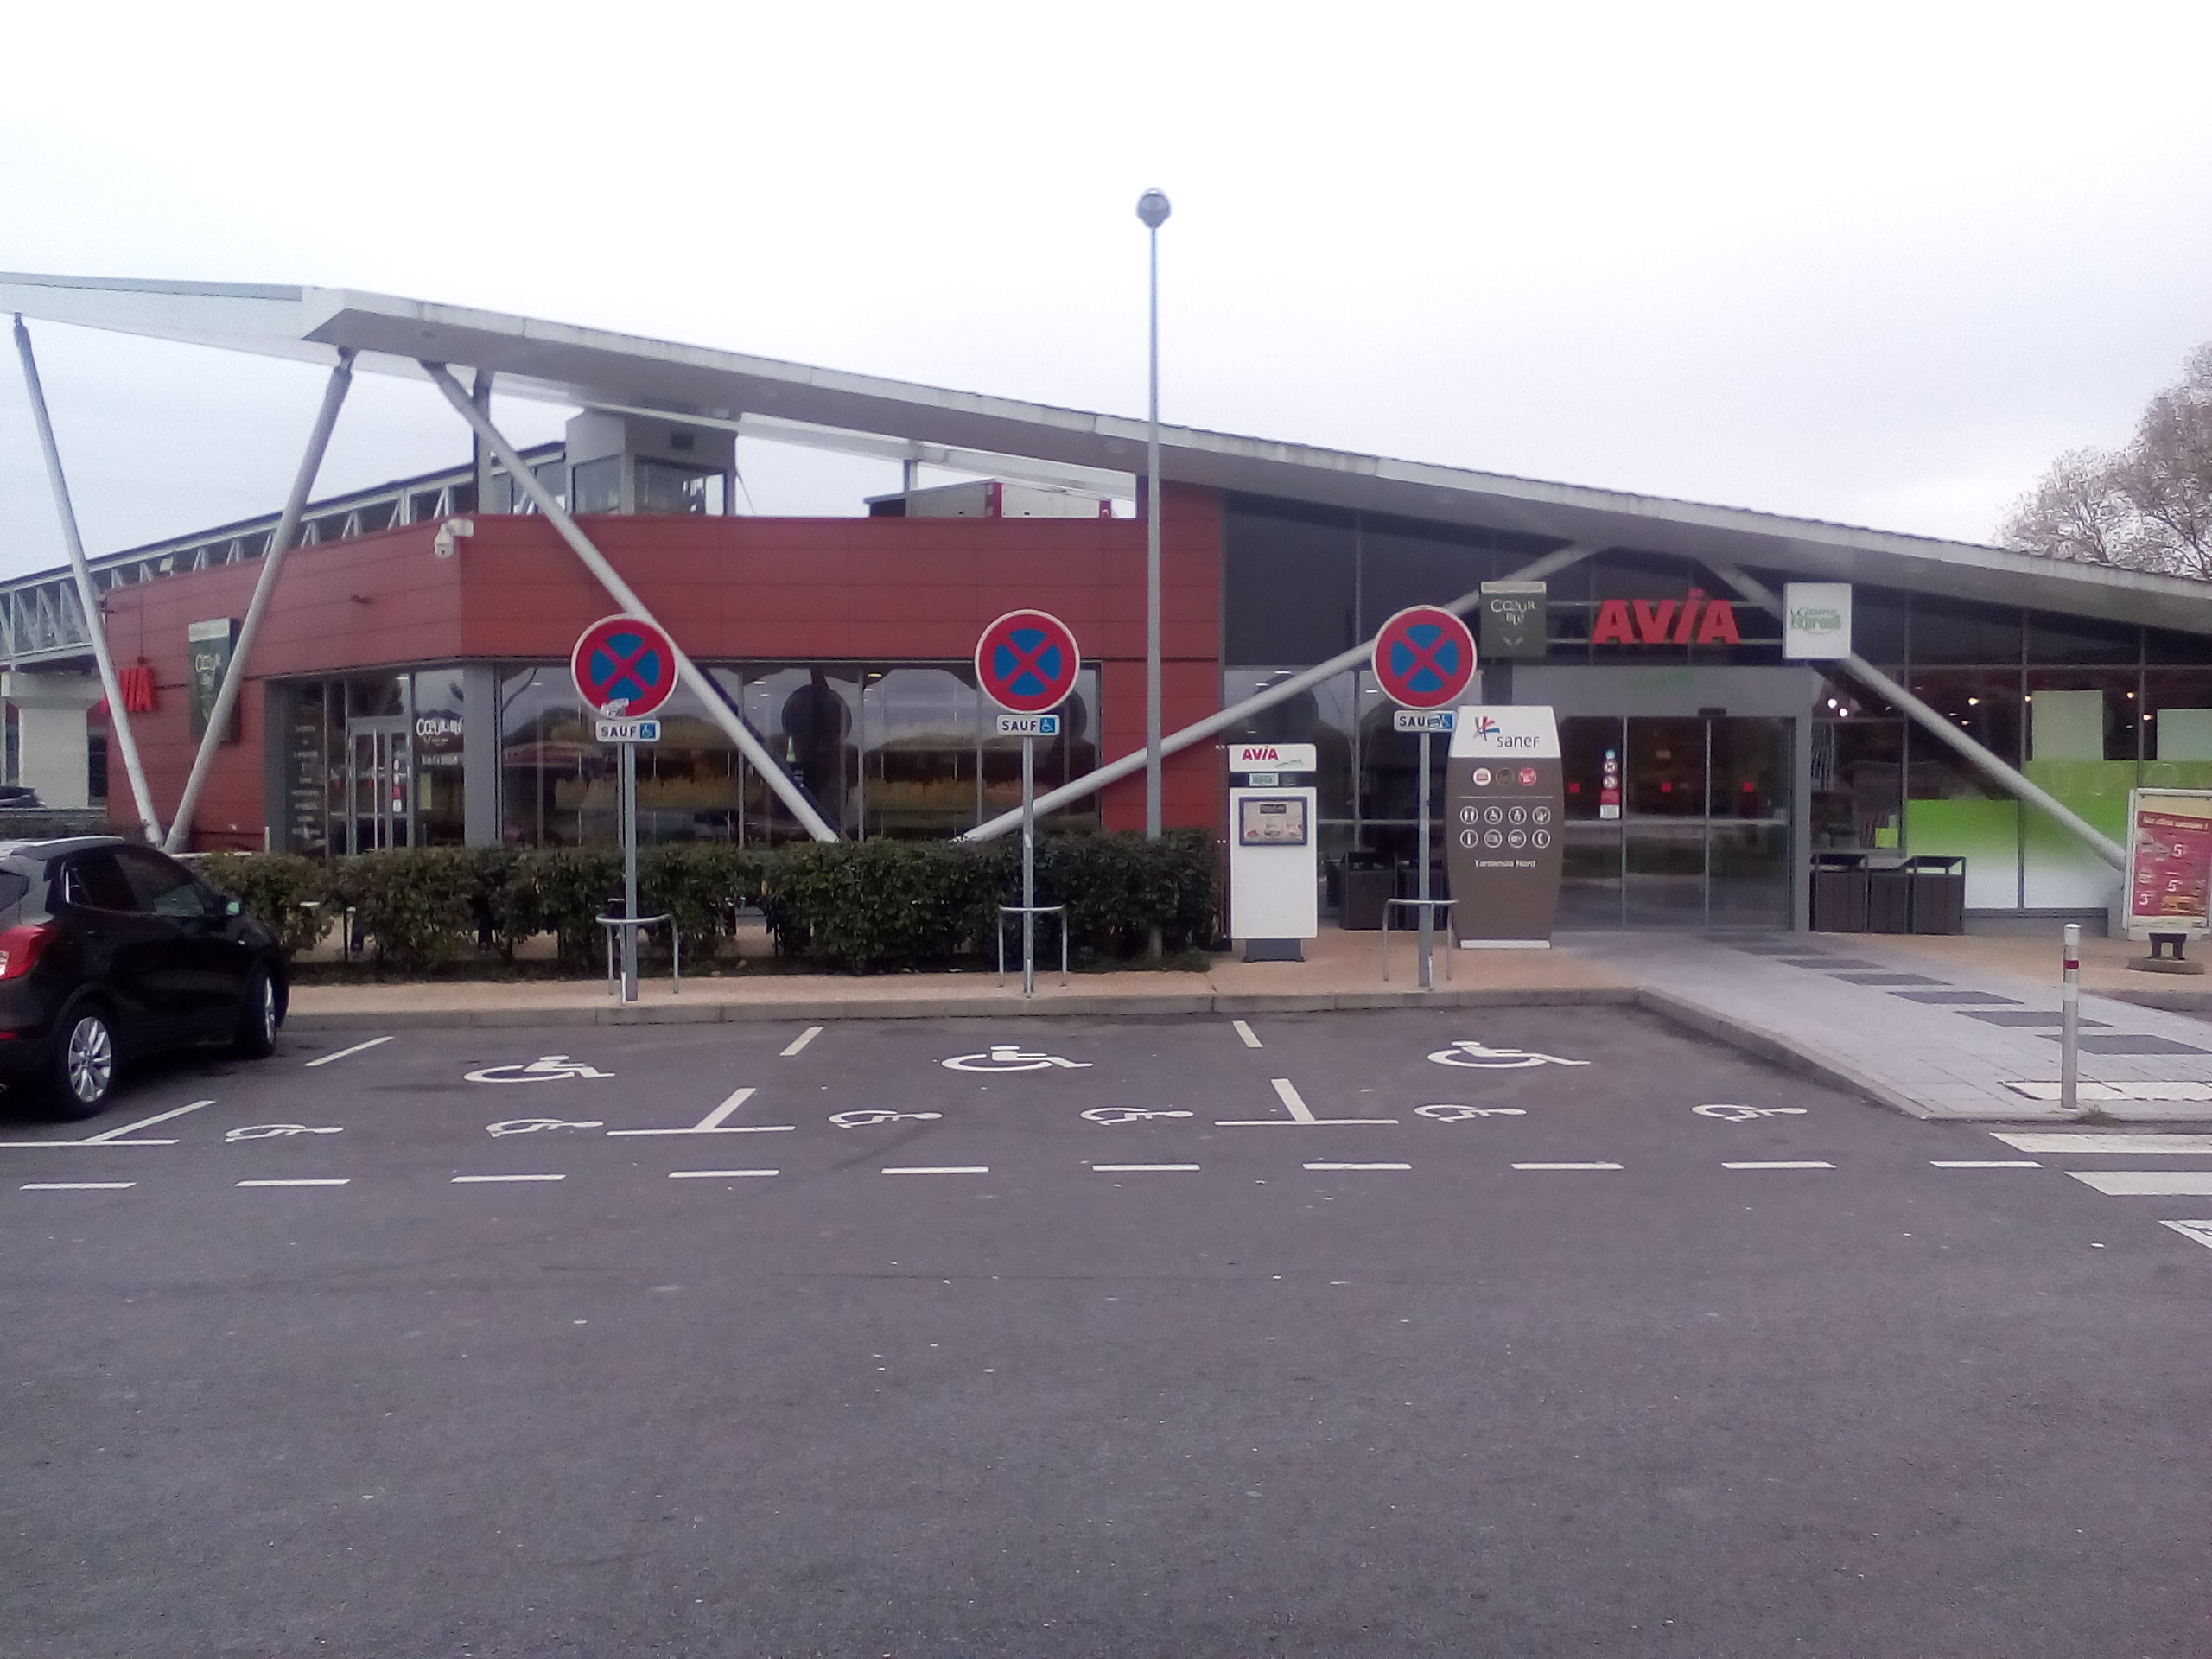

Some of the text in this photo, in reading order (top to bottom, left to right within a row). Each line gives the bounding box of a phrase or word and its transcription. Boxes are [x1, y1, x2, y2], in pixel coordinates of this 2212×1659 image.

[1592, 588, 1740, 644] AVIA
[1002, 720, 1037, 731] SAUF
[1399, 715, 1432, 728] SAU
[601, 726, 637, 738] SAUF
[1242, 746, 1278, 760] AVIA
